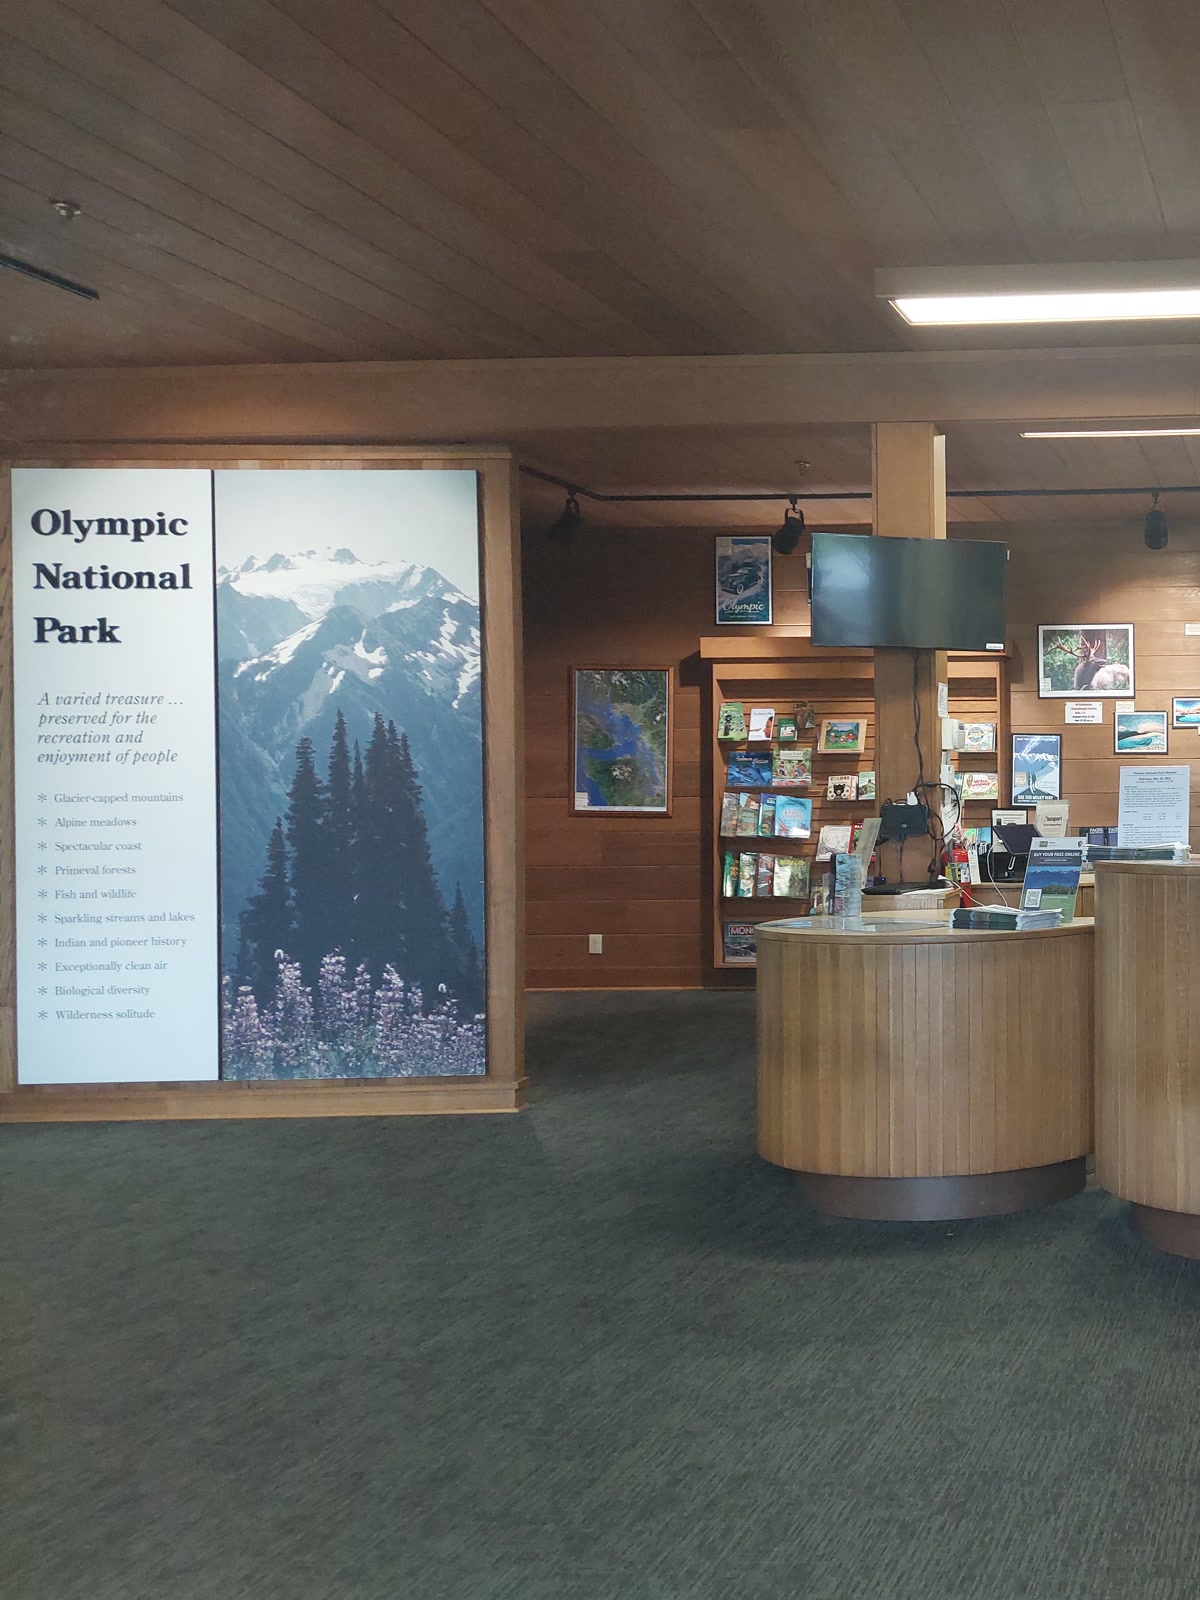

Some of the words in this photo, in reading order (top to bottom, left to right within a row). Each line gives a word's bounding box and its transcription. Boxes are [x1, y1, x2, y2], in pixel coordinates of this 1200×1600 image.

[30, 508, 190, 543] Olympic
[32, 562, 193, 591] National
[723, 599, 765, 614] Olympic
[33, 616, 122, 645] Park
[37, 692, 51, 706] A
[55, 691, 102, 706] varied
[105, 693, 165, 706] treasure
[38, 711, 108, 728] preserved
[109, 711, 133, 727] for
[135, 711, 158, 725] the
[37, 730, 111, 744] recreation
[115, 730, 144, 744] and
[37, 750, 111, 766] enjoyment
[115, 749, 131, 765] of
[132, 749, 178, 766] people
[54, 793, 129, 805] Glacier-capped
[131, 792, 184, 803] mountains
[54, 817, 88, 829] Alpine
[89, 817, 138, 827] meadows
[54, 841, 114, 853] Spectacular
[115, 842, 143, 851] coast
[54, 865, 99, 876] Primeval
[102, 865, 137, 875] forests
[54, 889, 77, 900] Fish
[79, 889, 98, 899] and
[100, 888, 137, 899] wildlife
[54, 913, 103, 925] Sparkling
[105, 914, 146, 923] streams
[147, 912, 167, 922] and
[168, 912, 196, 922] lakes
[730, 927, 753, 935] MON
[54, 938, 87, 948] Indian
[89, 937, 108, 947] and
[110, 937, 149, 948] pioneer
[151, 936, 188, 947] history
[54, 961, 124, 973] Exceptionally
[125, 961, 152, 971] clean
[153, 960, 168, 970] air
[54, 985, 105, 997] Biological
[106, 985, 151, 996] diversity
[55, 1009, 114, 1020] Wilderness
[115, 1009, 156, 1019] solitude
